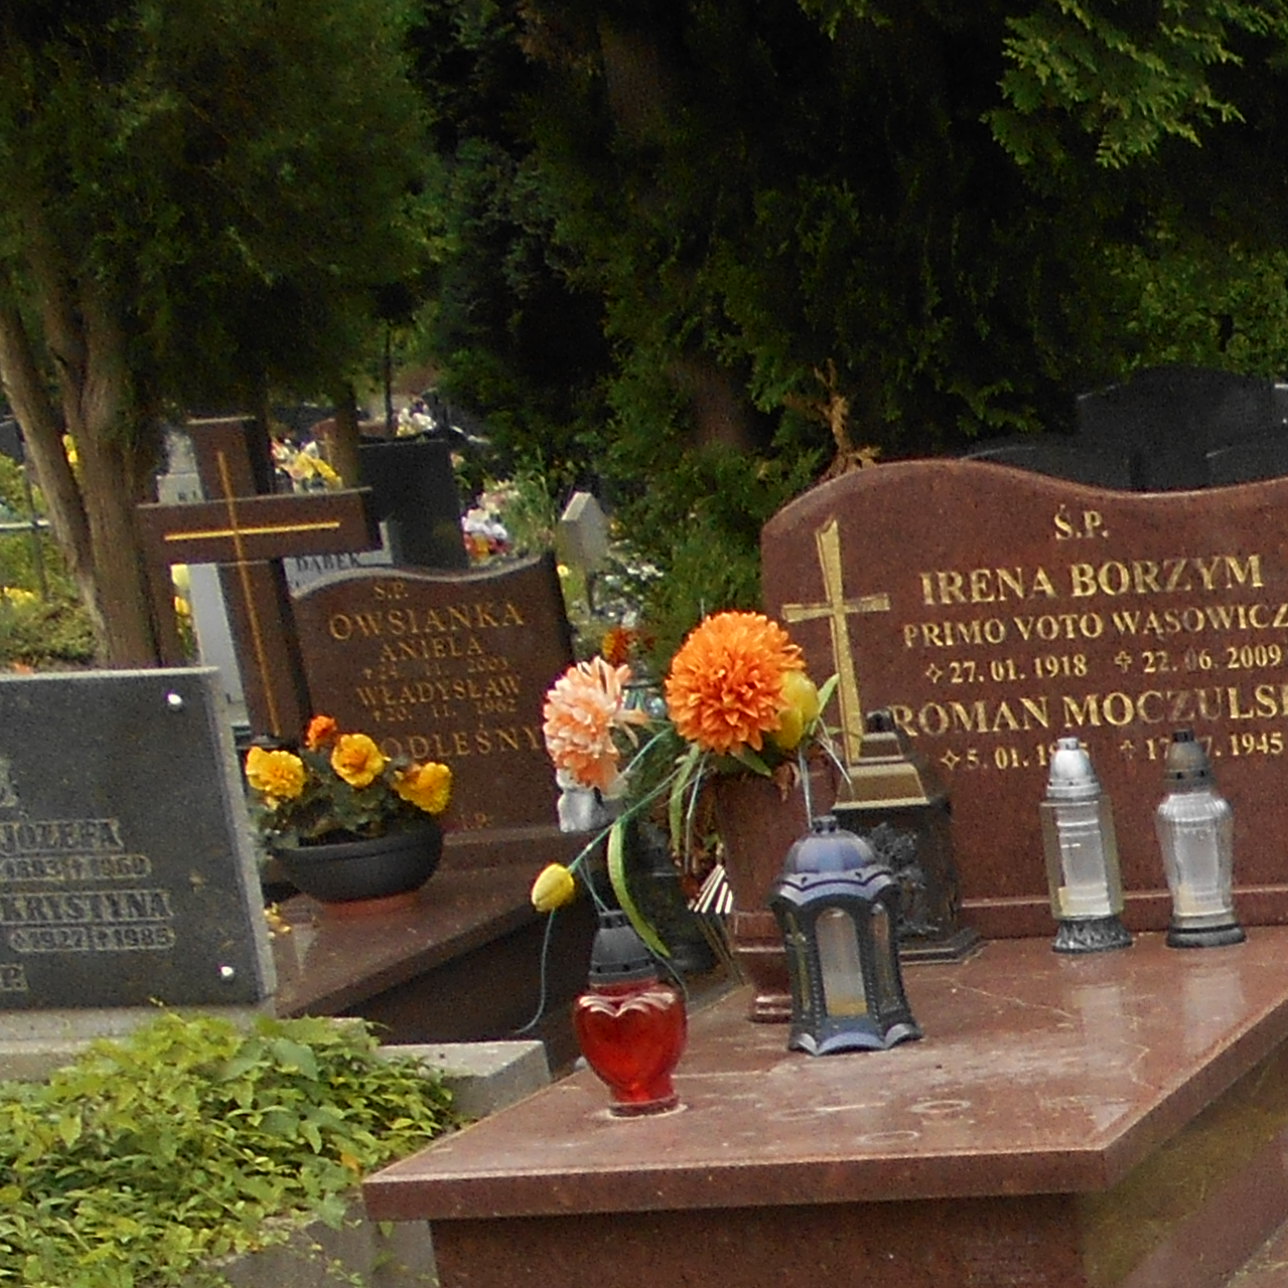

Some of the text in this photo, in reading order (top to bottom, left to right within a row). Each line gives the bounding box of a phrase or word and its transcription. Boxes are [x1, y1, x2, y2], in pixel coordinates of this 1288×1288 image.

[1053, 504, 1109, 541] Ś.P.
[920, 554, 1266, 606] IRENA BORZYM
[328, 603, 525, 640] OWSIANKA
[903, 618, 1006, 648] PRIMO
[1014, 612, 1103, 641] VOTO
[380, 637, 484, 662] ANIELA
[949, 661, 984, 685] 27.
[990, 657, 1025, 683] 01.
[1034, 654, 1087, 679] 1918
[1142, 651, 1178, 674] 22.
[1227, 644, 1282, 670] 2009
[356, 676, 522, 707] WŁADYSŁAW
[893, 696, 1049, 737] ROMAN
[379, 723, 541, 760] ODLEŚNY
[995, 746, 1029, 768] 01.
[1230, 732, 1284, 756] 1945
